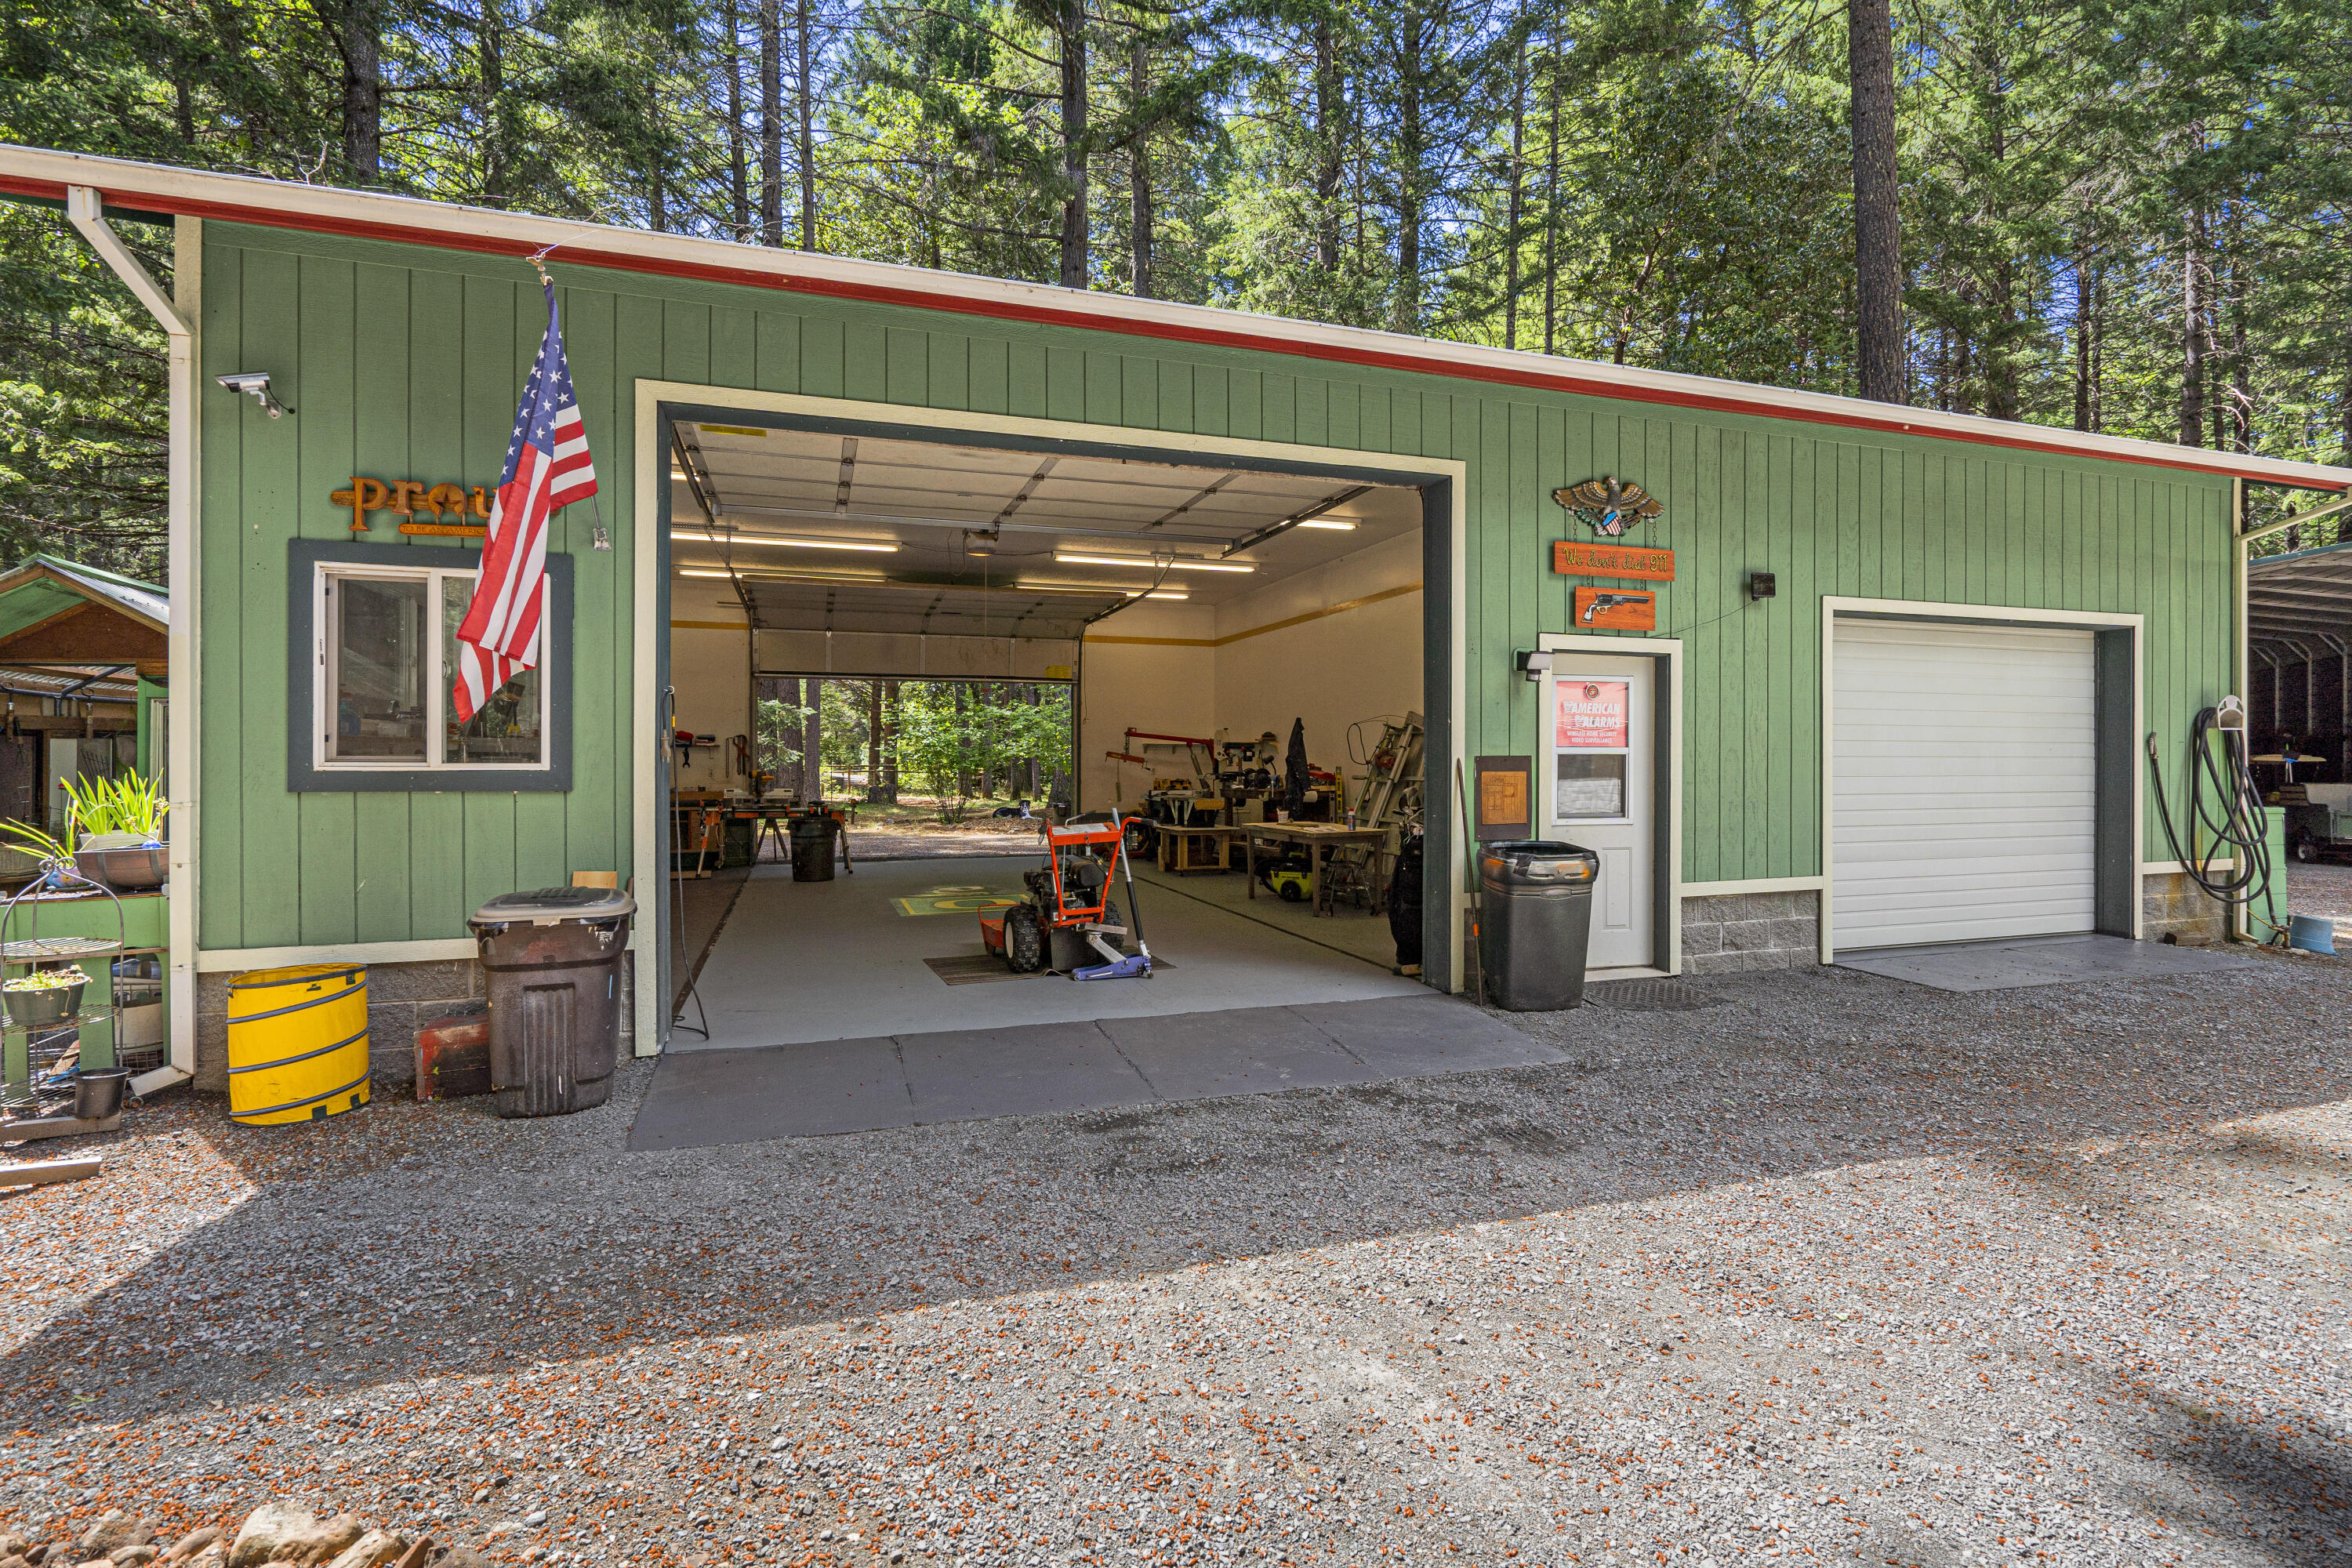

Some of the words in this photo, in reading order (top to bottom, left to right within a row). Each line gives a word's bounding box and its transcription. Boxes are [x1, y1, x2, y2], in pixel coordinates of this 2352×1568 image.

[1563, 547, 1583, 566] We
[1588, 550, 1617, 568] don't
[1622, 552, 1646, 570] dial
[1650, 554, 1668, 572] 911
[1570, 702, 1621, 714] AMERICAN
[1582, 717, 1621, 728] ALARMS
